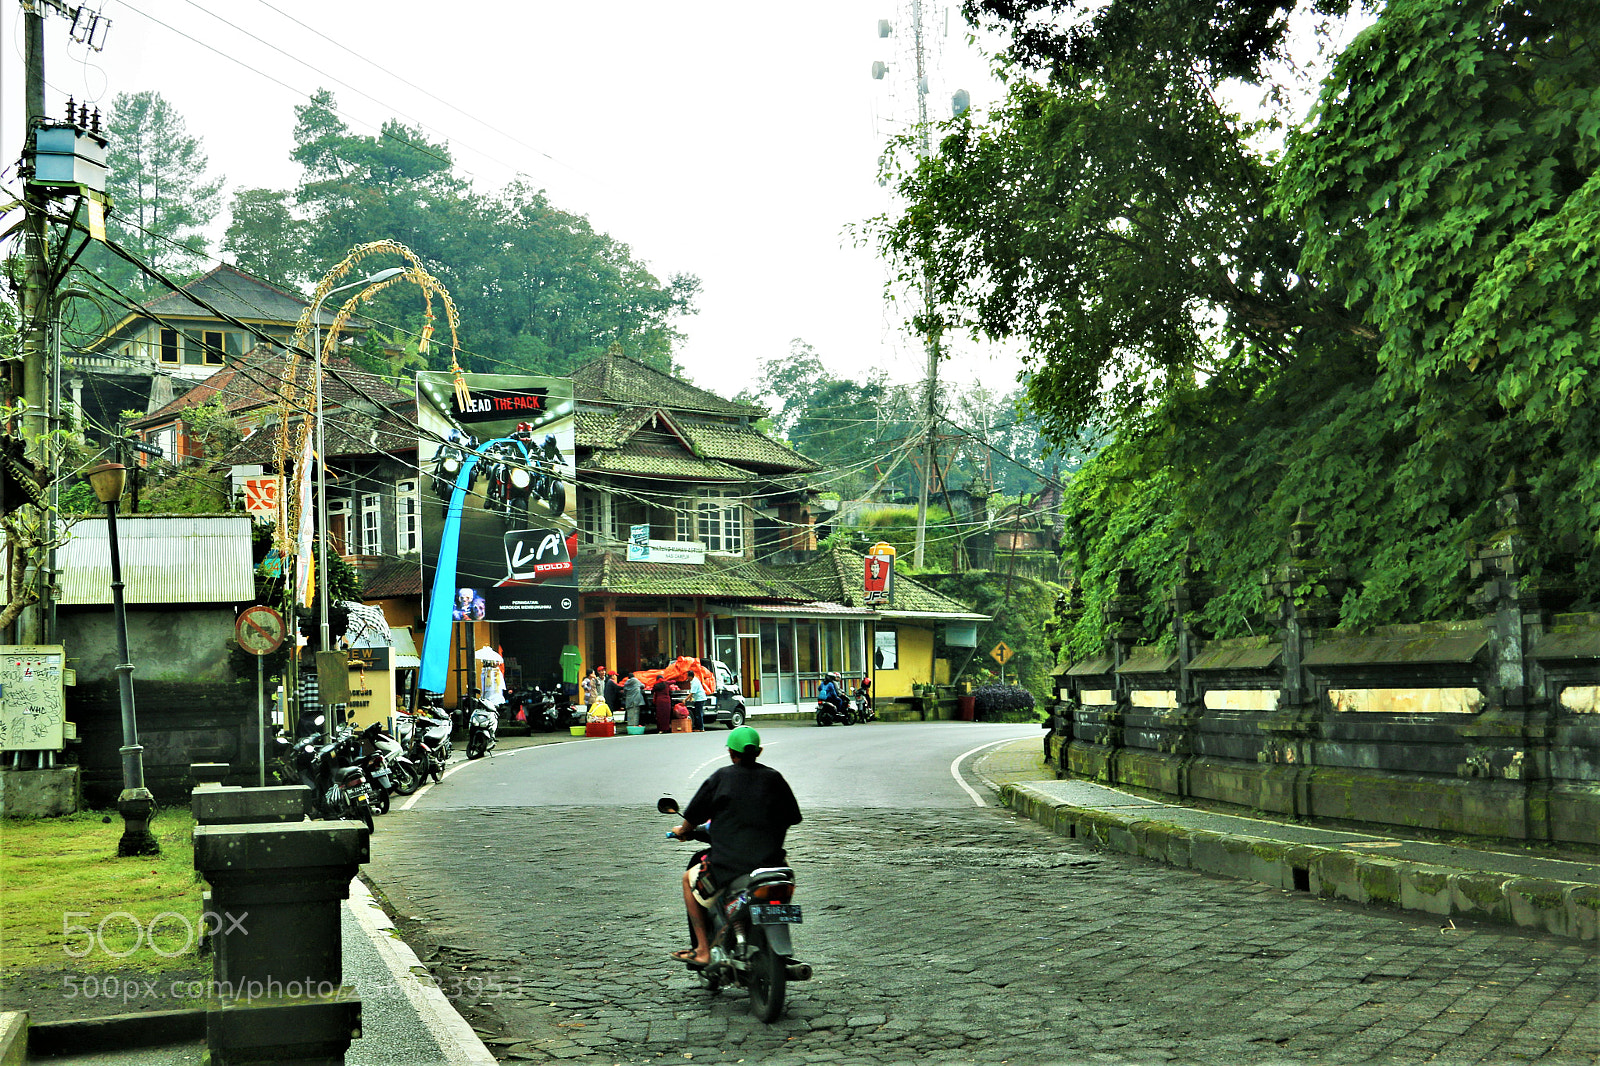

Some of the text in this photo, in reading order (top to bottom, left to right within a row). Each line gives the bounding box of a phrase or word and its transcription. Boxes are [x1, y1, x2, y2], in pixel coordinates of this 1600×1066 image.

[465, 395, 540, 413] LEAD THE PACK
[536, 563, 563, 571] BOLD
